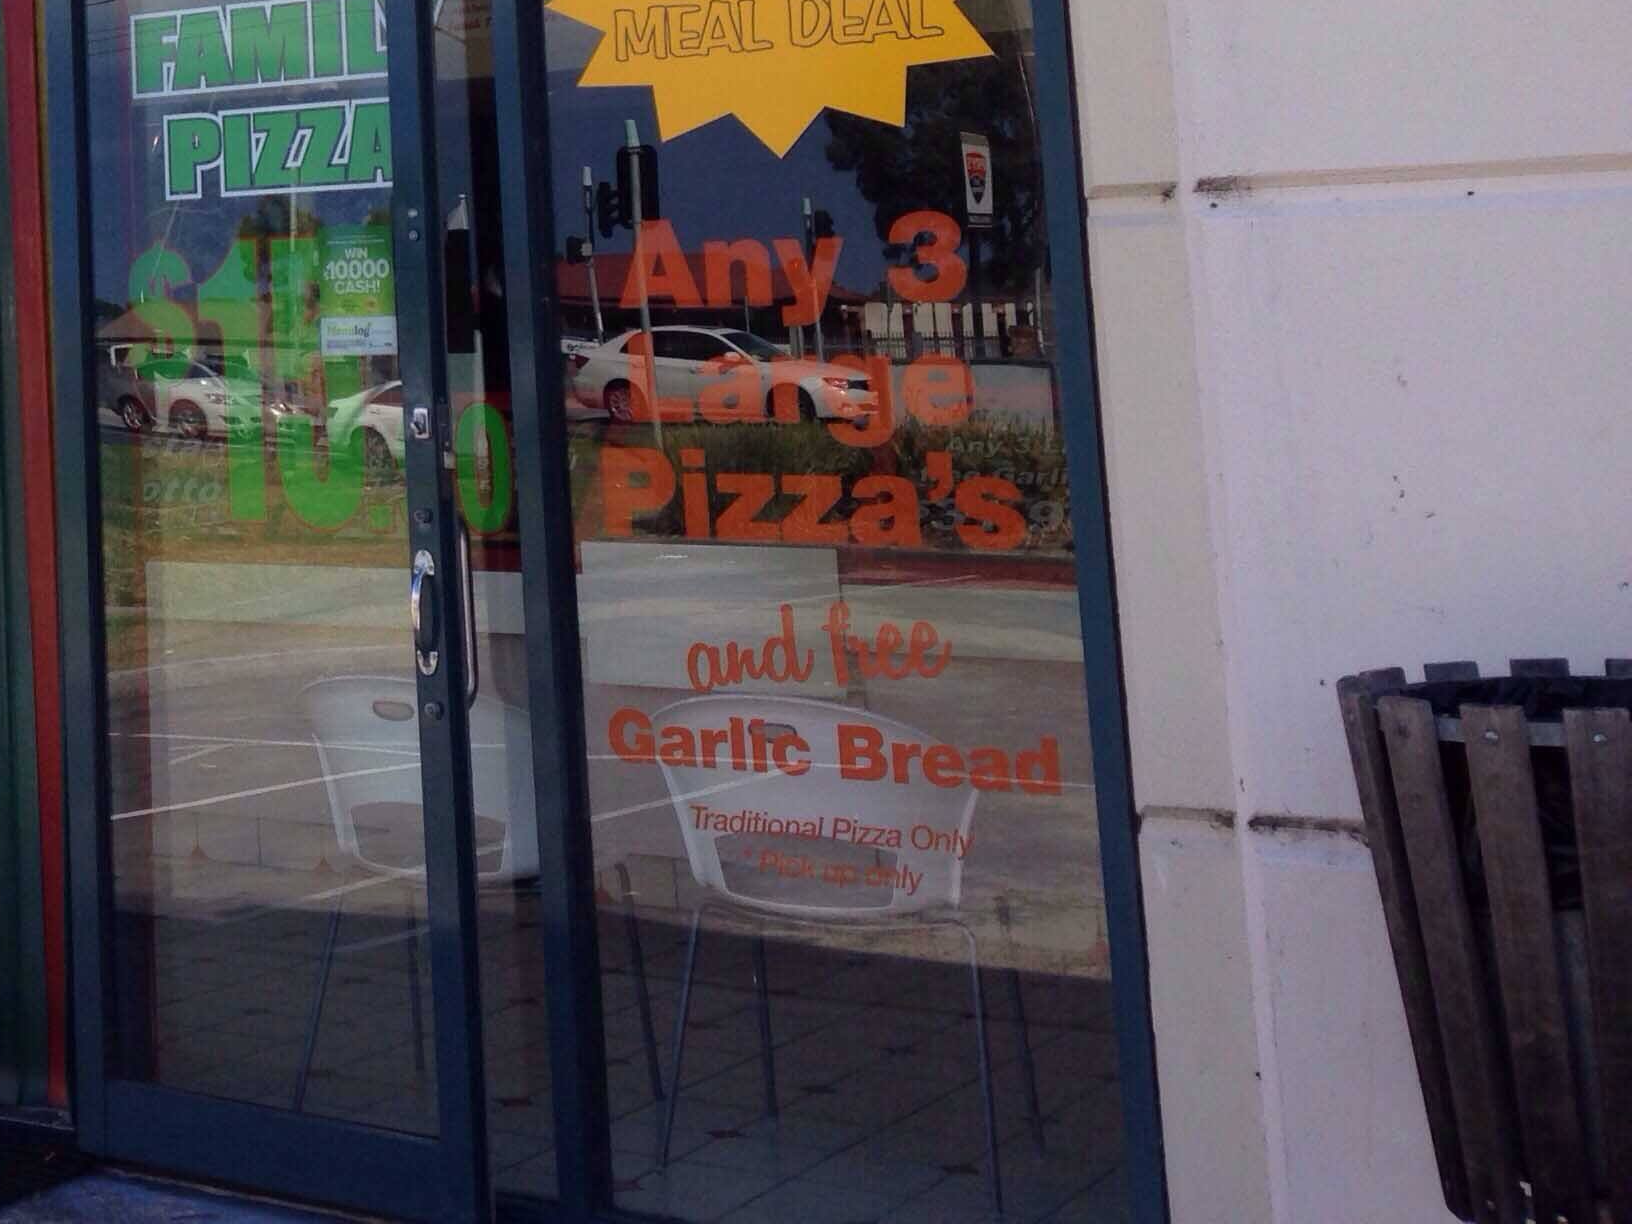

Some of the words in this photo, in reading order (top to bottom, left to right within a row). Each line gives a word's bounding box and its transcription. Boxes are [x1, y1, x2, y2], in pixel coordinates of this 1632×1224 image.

[613, 0, 773, 63] MEAL
[164, 97, 392, 200] PIZZA
[335, 280, 381, 294] CASH!
[344, 247, 368, 259] WIN
[620, 218, 844, 327] Any
[886, 210, 968, 303] 3
[621, 332, 975, 448] Large
[597, 446, 1028, 551] Pizza's
[686, 603, 815, 693] and
[820, 601, 952, 688] free
[607, 708, 812, 777] Garlic
[836, 722, 1063, 796] Bread
[689, 804, 824, 840] Traditional
[831, 817, 902, 849] Pizza
[910, 824, 975, 858] Only
[759, 848, 816, 879] Pick
[821, 861, 859, 889] up
[865, 863, 923, 896] only
